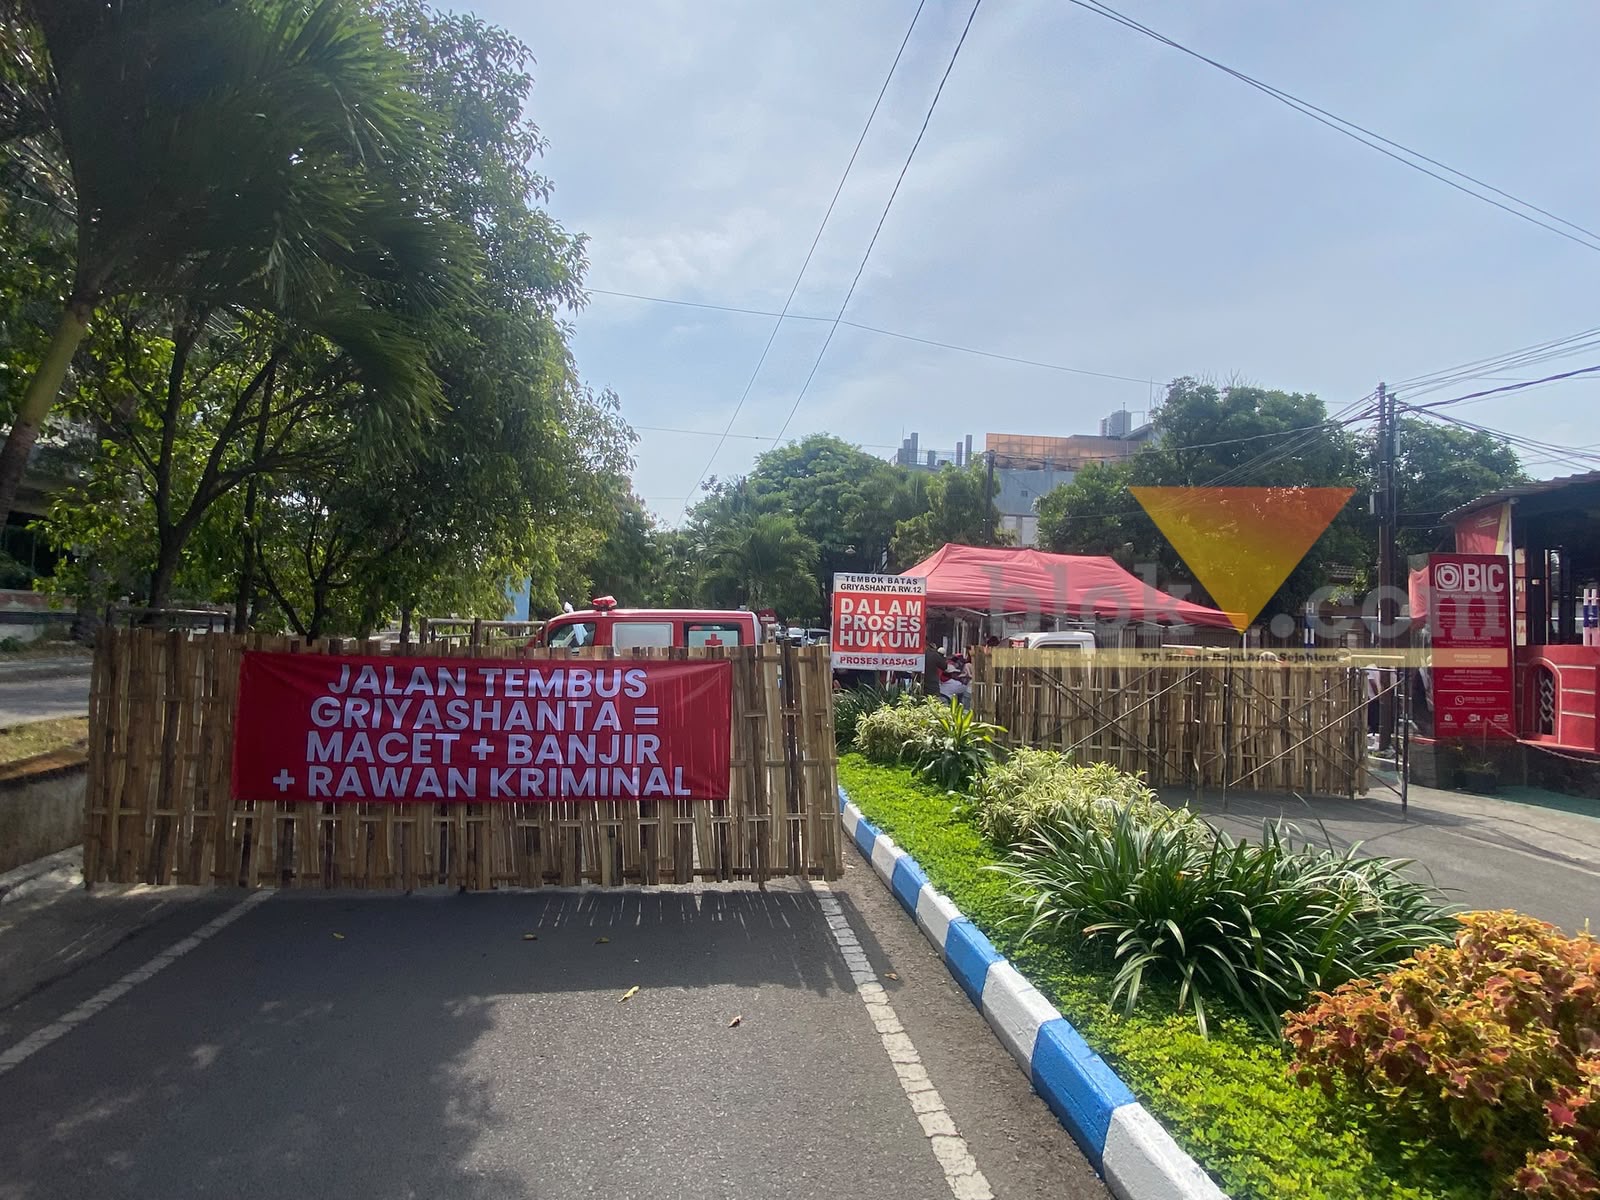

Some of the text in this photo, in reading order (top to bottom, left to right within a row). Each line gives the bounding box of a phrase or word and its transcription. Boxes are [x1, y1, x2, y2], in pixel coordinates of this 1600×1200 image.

[845, 575, 918, 585] TEMBOK BATAS
[1463, 563, 1505, 593] BIC
[840, 583, 922, 593] GRIYASHANTA RW.12
[840, 597, 922, 616] DALAM
[839, 614, 921, 632] PROSES
[839, 630, 920, 648] HUKUM
[839, 656, 918, 666] PROSES KASASI
[327, 664, 648, 699] JALAN TEMBUS
[310, 696, 660, 733] GRIYASHANTA =
[304, 731, 661, 766] MACET + BANJIR
[272, 765, 692, 798] + RAWAN KRIMINAL
